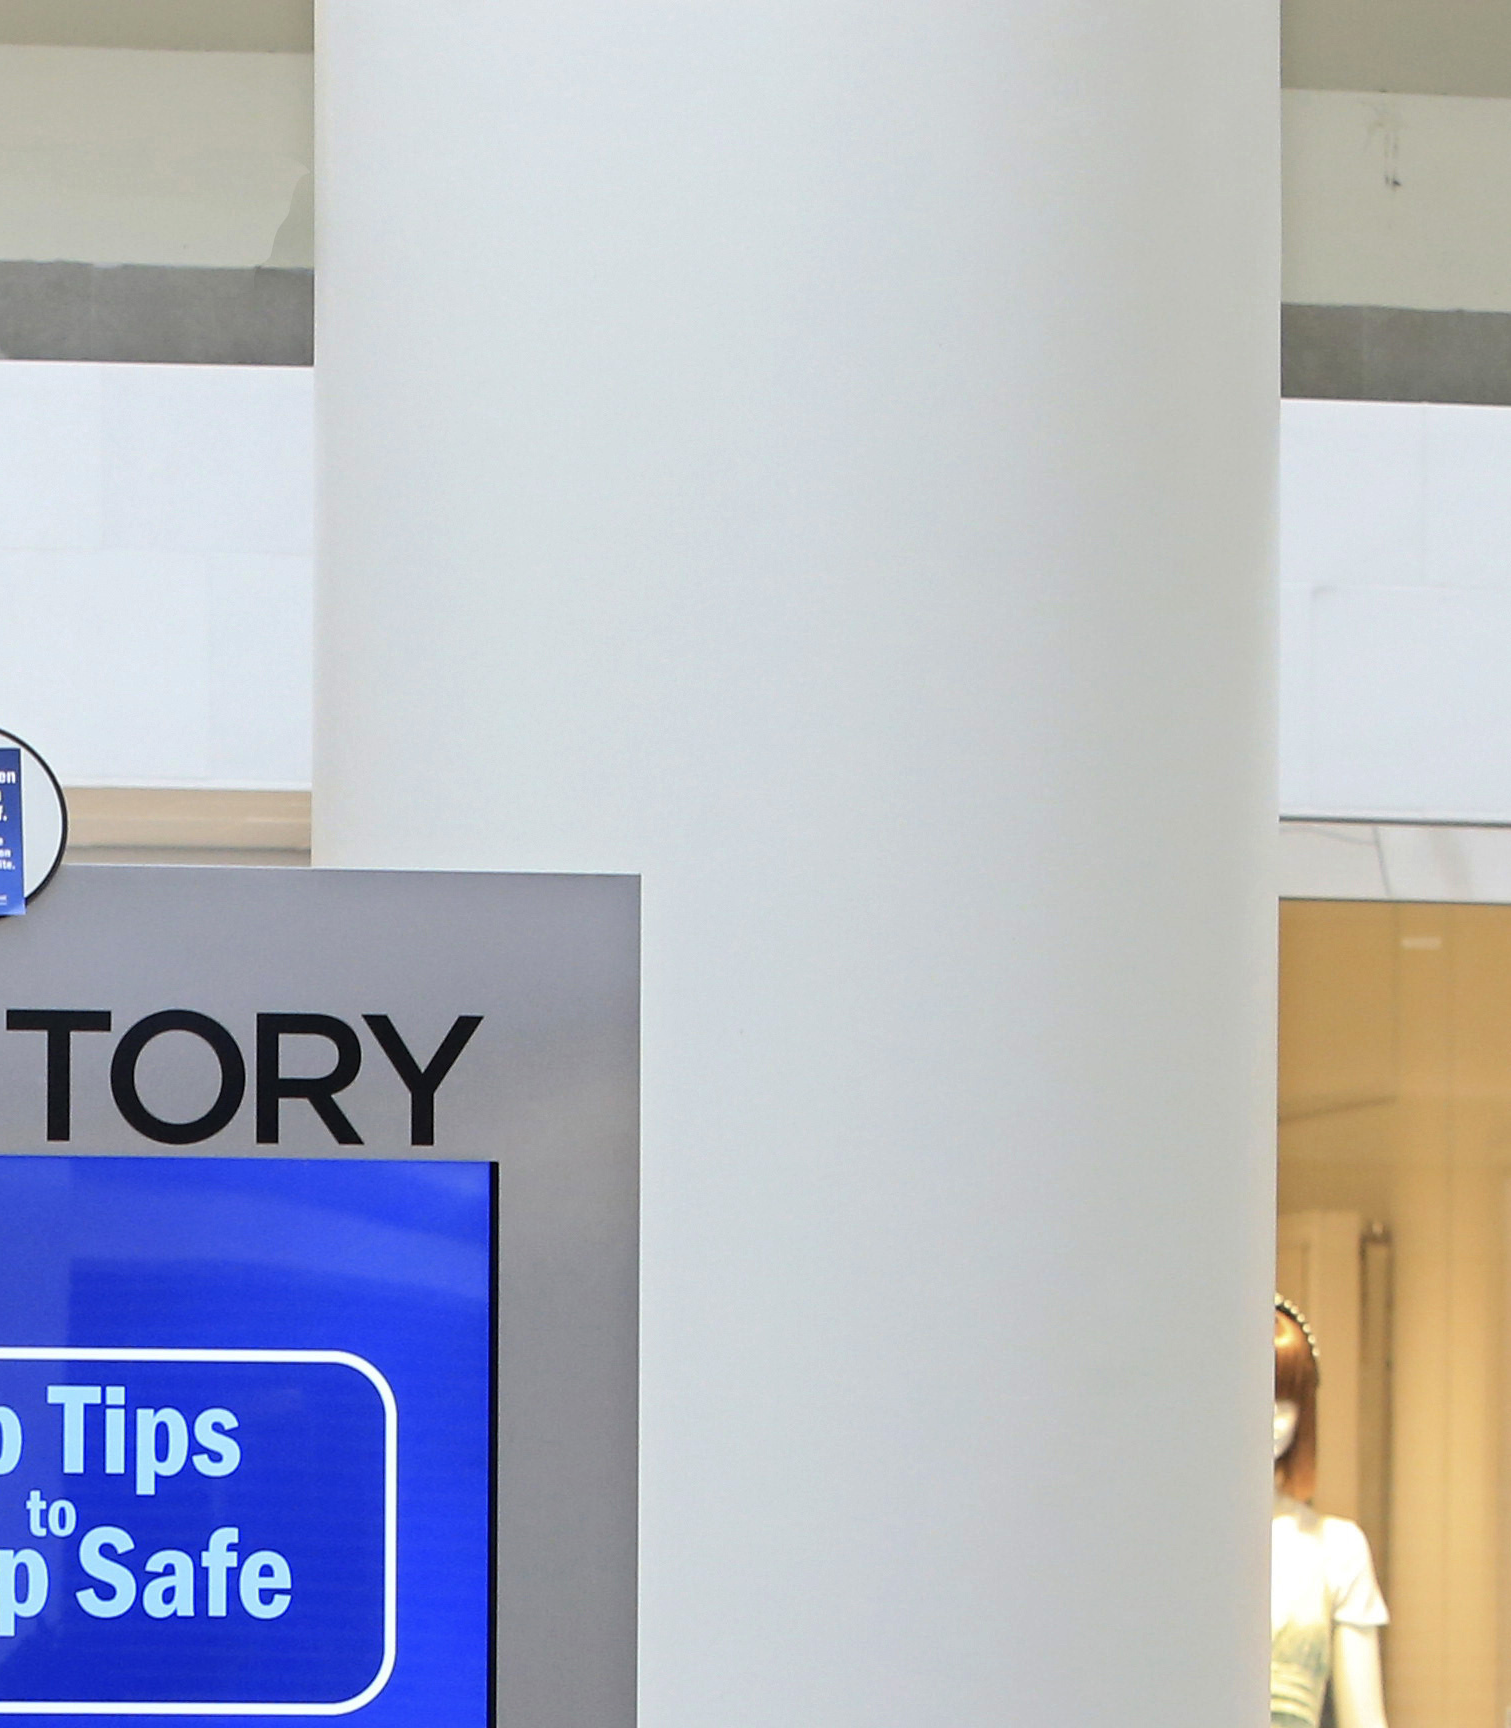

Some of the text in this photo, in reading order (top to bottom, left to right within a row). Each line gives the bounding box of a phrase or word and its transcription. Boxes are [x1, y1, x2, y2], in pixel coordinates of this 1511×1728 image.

[0, 849, 11, 857] on
[47, 1385, 240, 1495] Tips
[26, 1490, 76, 1537] to
[76, 1526, 291, 1618] Safe
